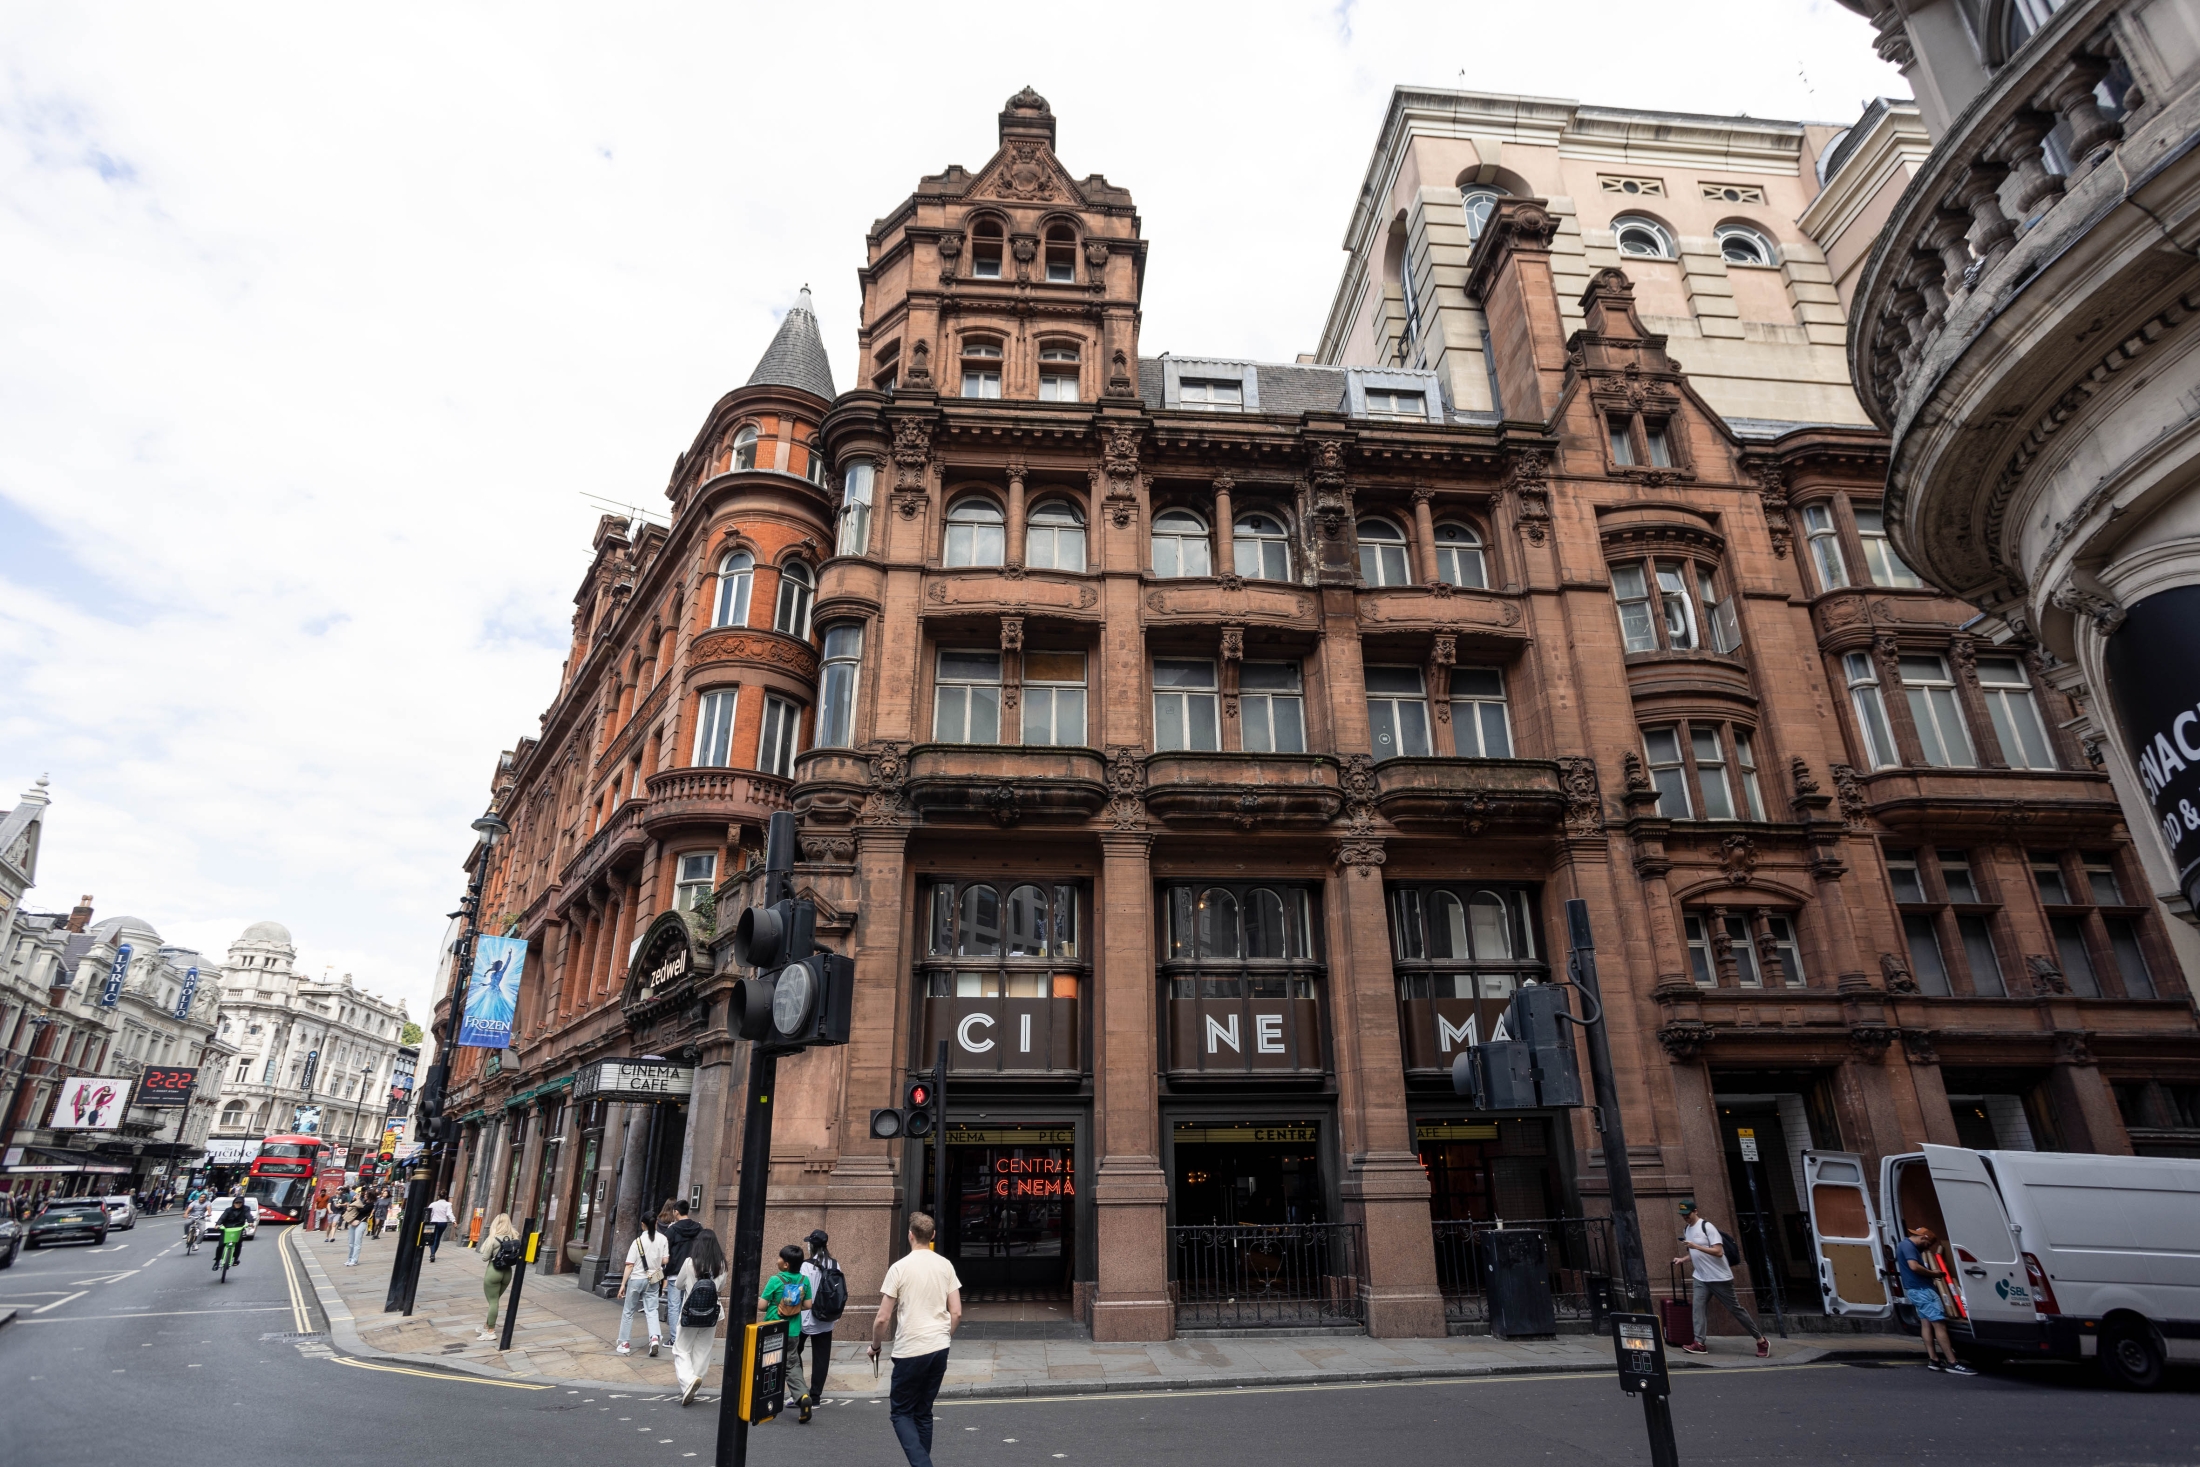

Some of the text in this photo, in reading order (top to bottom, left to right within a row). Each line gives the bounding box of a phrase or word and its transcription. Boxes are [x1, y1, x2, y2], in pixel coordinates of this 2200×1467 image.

[2138, 701, 2200, 806] SNAC
[650, 948, 687, 988] zedwell
[103, 954, 127, 1002] LYRIC
[176, 974, 196, 1017] APOLLO
[464, 1015, 511, 1032] FROZEN
[957, 1012, 1513, 1053] CI NE MA
[146, 1071, 192, 1089] 2:22
[620, 1063, 680, 1079] CINEMA
[630, 1078, 669, 1091] CAFE
[996, 1158, 1075, 1174] CENTRAL
[996, 1178, 1075, 1196] CNEMA
[2009, 1286, 2029, 1297] SBL
[764, 1350, 782, 1366] WAIT
